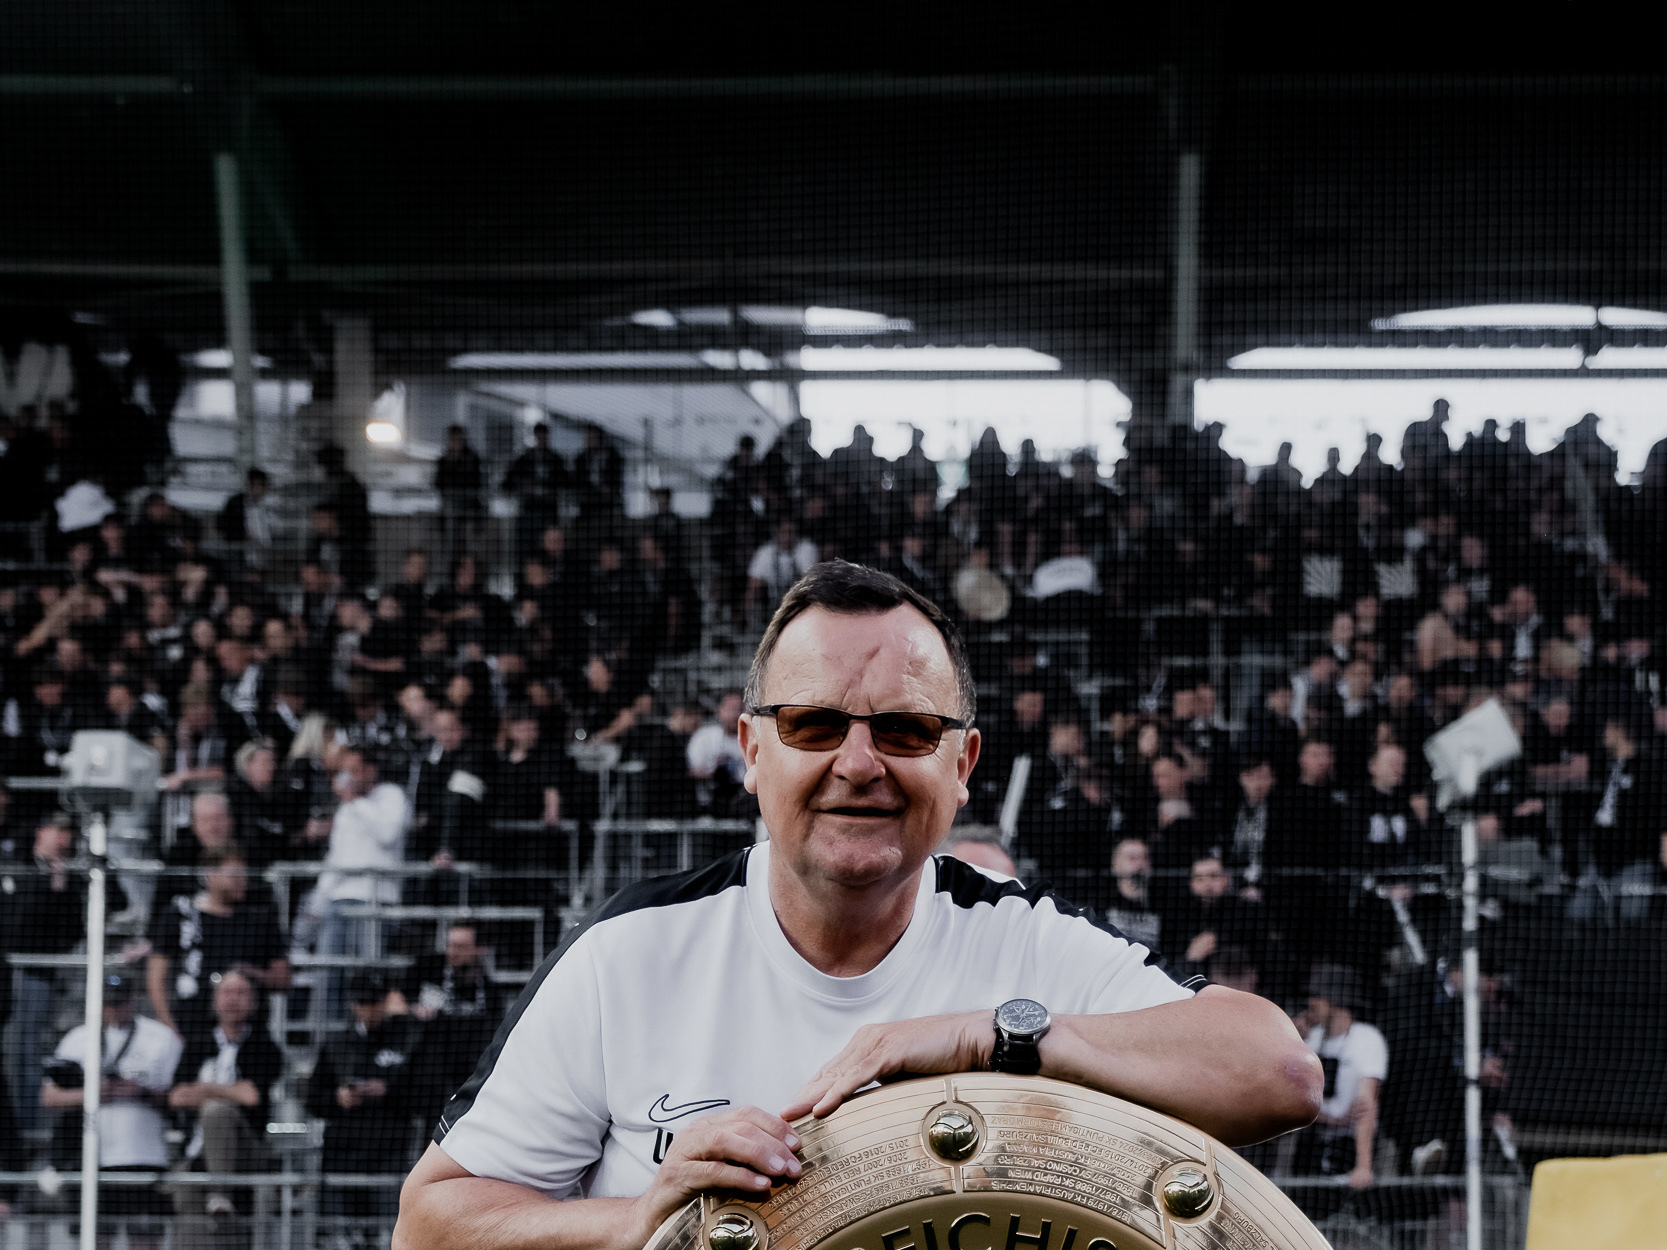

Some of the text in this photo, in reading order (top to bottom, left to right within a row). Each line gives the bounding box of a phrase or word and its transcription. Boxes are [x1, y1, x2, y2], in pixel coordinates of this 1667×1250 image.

[998, 1129, 1045, 1142] SALZBURG
[1046, 1120, 1106, 1143] PUNTIGAMER
[1104, 1134, 1118, 1147] SK
[997, 1154, 1046, 1168] SALZBURG
[1045, 1159, 1080, 1175] CASINO
[1075, 1153, 1091, 1165] FK
[1102, 1148, 1150, 1175] 2014/2015
[1007, 1168, 1122, 1204] 1987/1988 SK RAPID WIEN
[1034, 1183, 1074, 1200] AUSTRIA
[1072, 1191, 1087, 1204] FK
[1085, 1196, 1133, 1223] 1978/1979
[1231, 1209, 1271, 1249] SALZBURG
